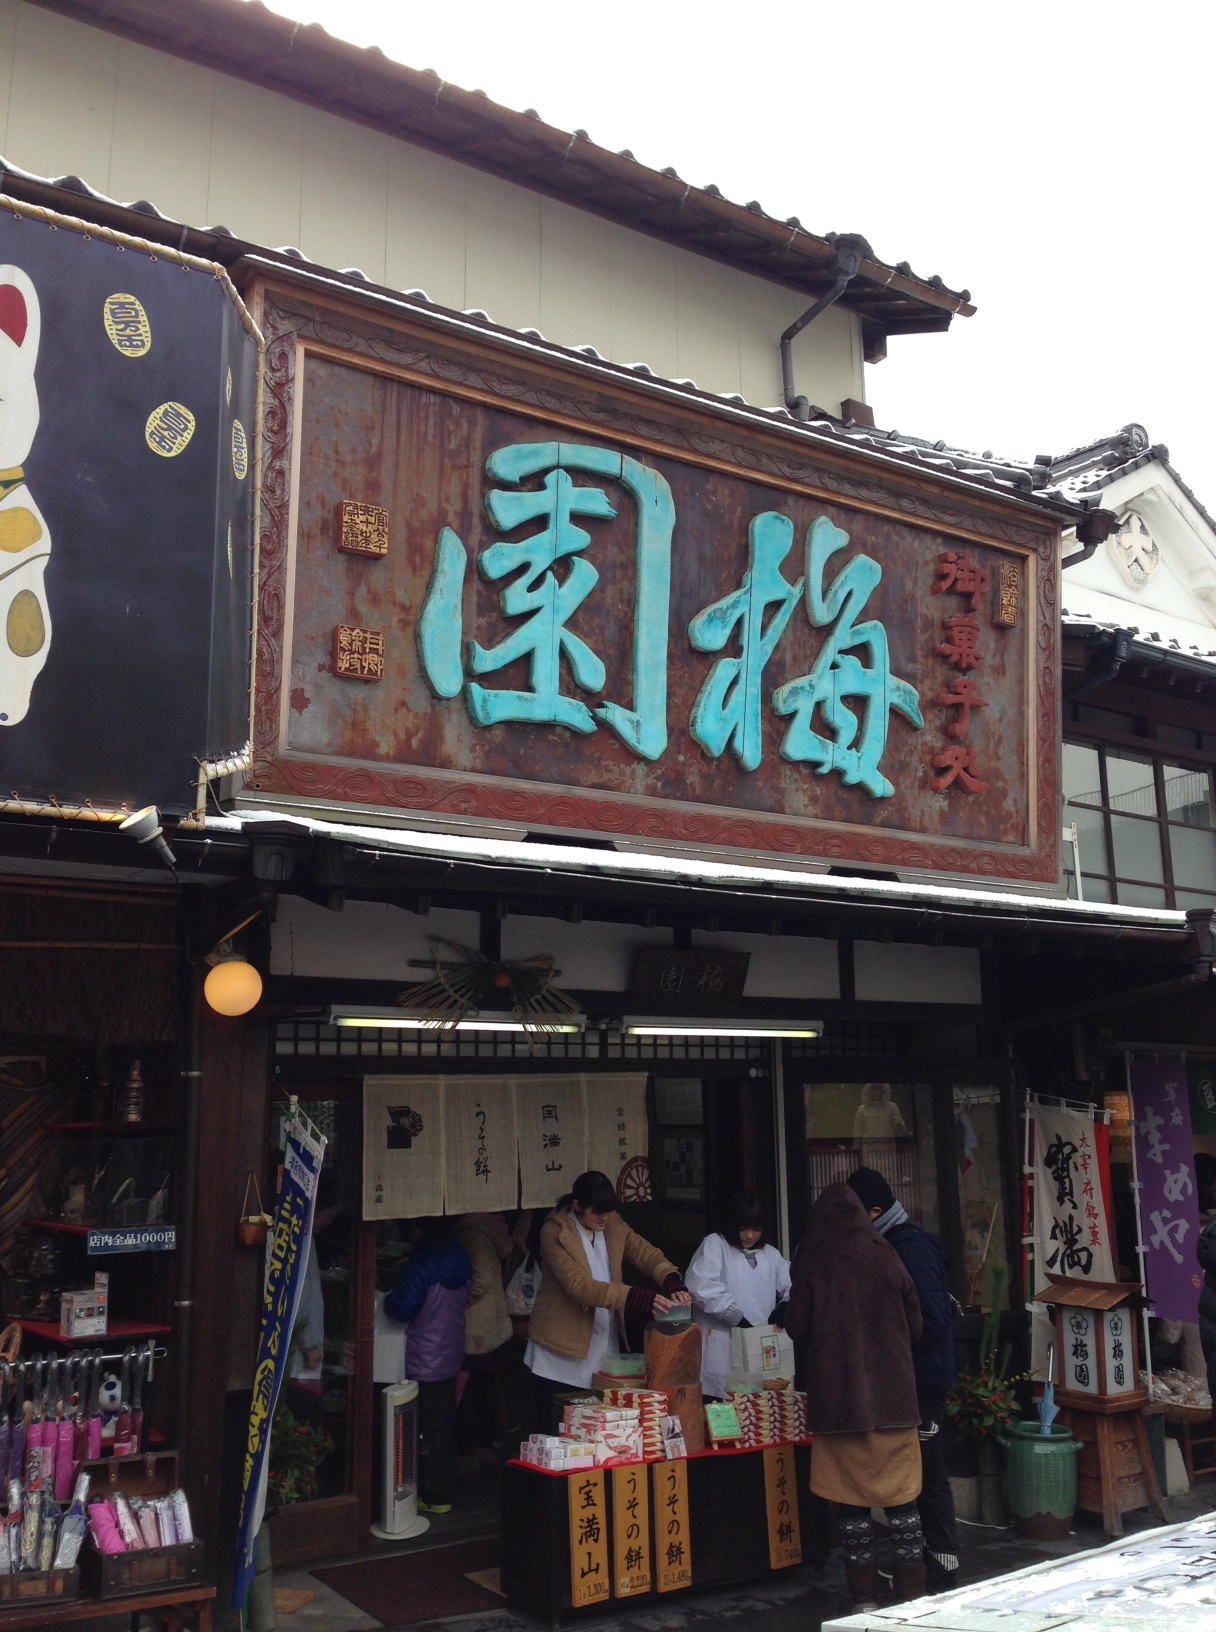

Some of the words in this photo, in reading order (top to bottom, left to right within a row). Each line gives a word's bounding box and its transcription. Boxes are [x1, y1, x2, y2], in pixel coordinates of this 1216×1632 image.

[418, 440, 924, 799] 梅園
[930, 549, 991, 794] 御菓子処
[473, 1103, 491, 1184] うその餅
[1078, 1131, 1102, 1246] 太宰府銘菓
[1139, 1105, 1193, 1264] まめや
[89, 1231, 175, 1247] 店内全品1000円
[1044, 1133, 1094, 1276] 寶満
[1072, 1336, 1089, 1387] 梅園
[1112, 1338, 1125, 1387] 梅園
[578, 1479, 600, 1578] 宝満山
[624, 1472, 645, 1571] うその餅
[665, 1469, 685, 1566] うその餅
[775, 1452, 794, 1544] うその餅
